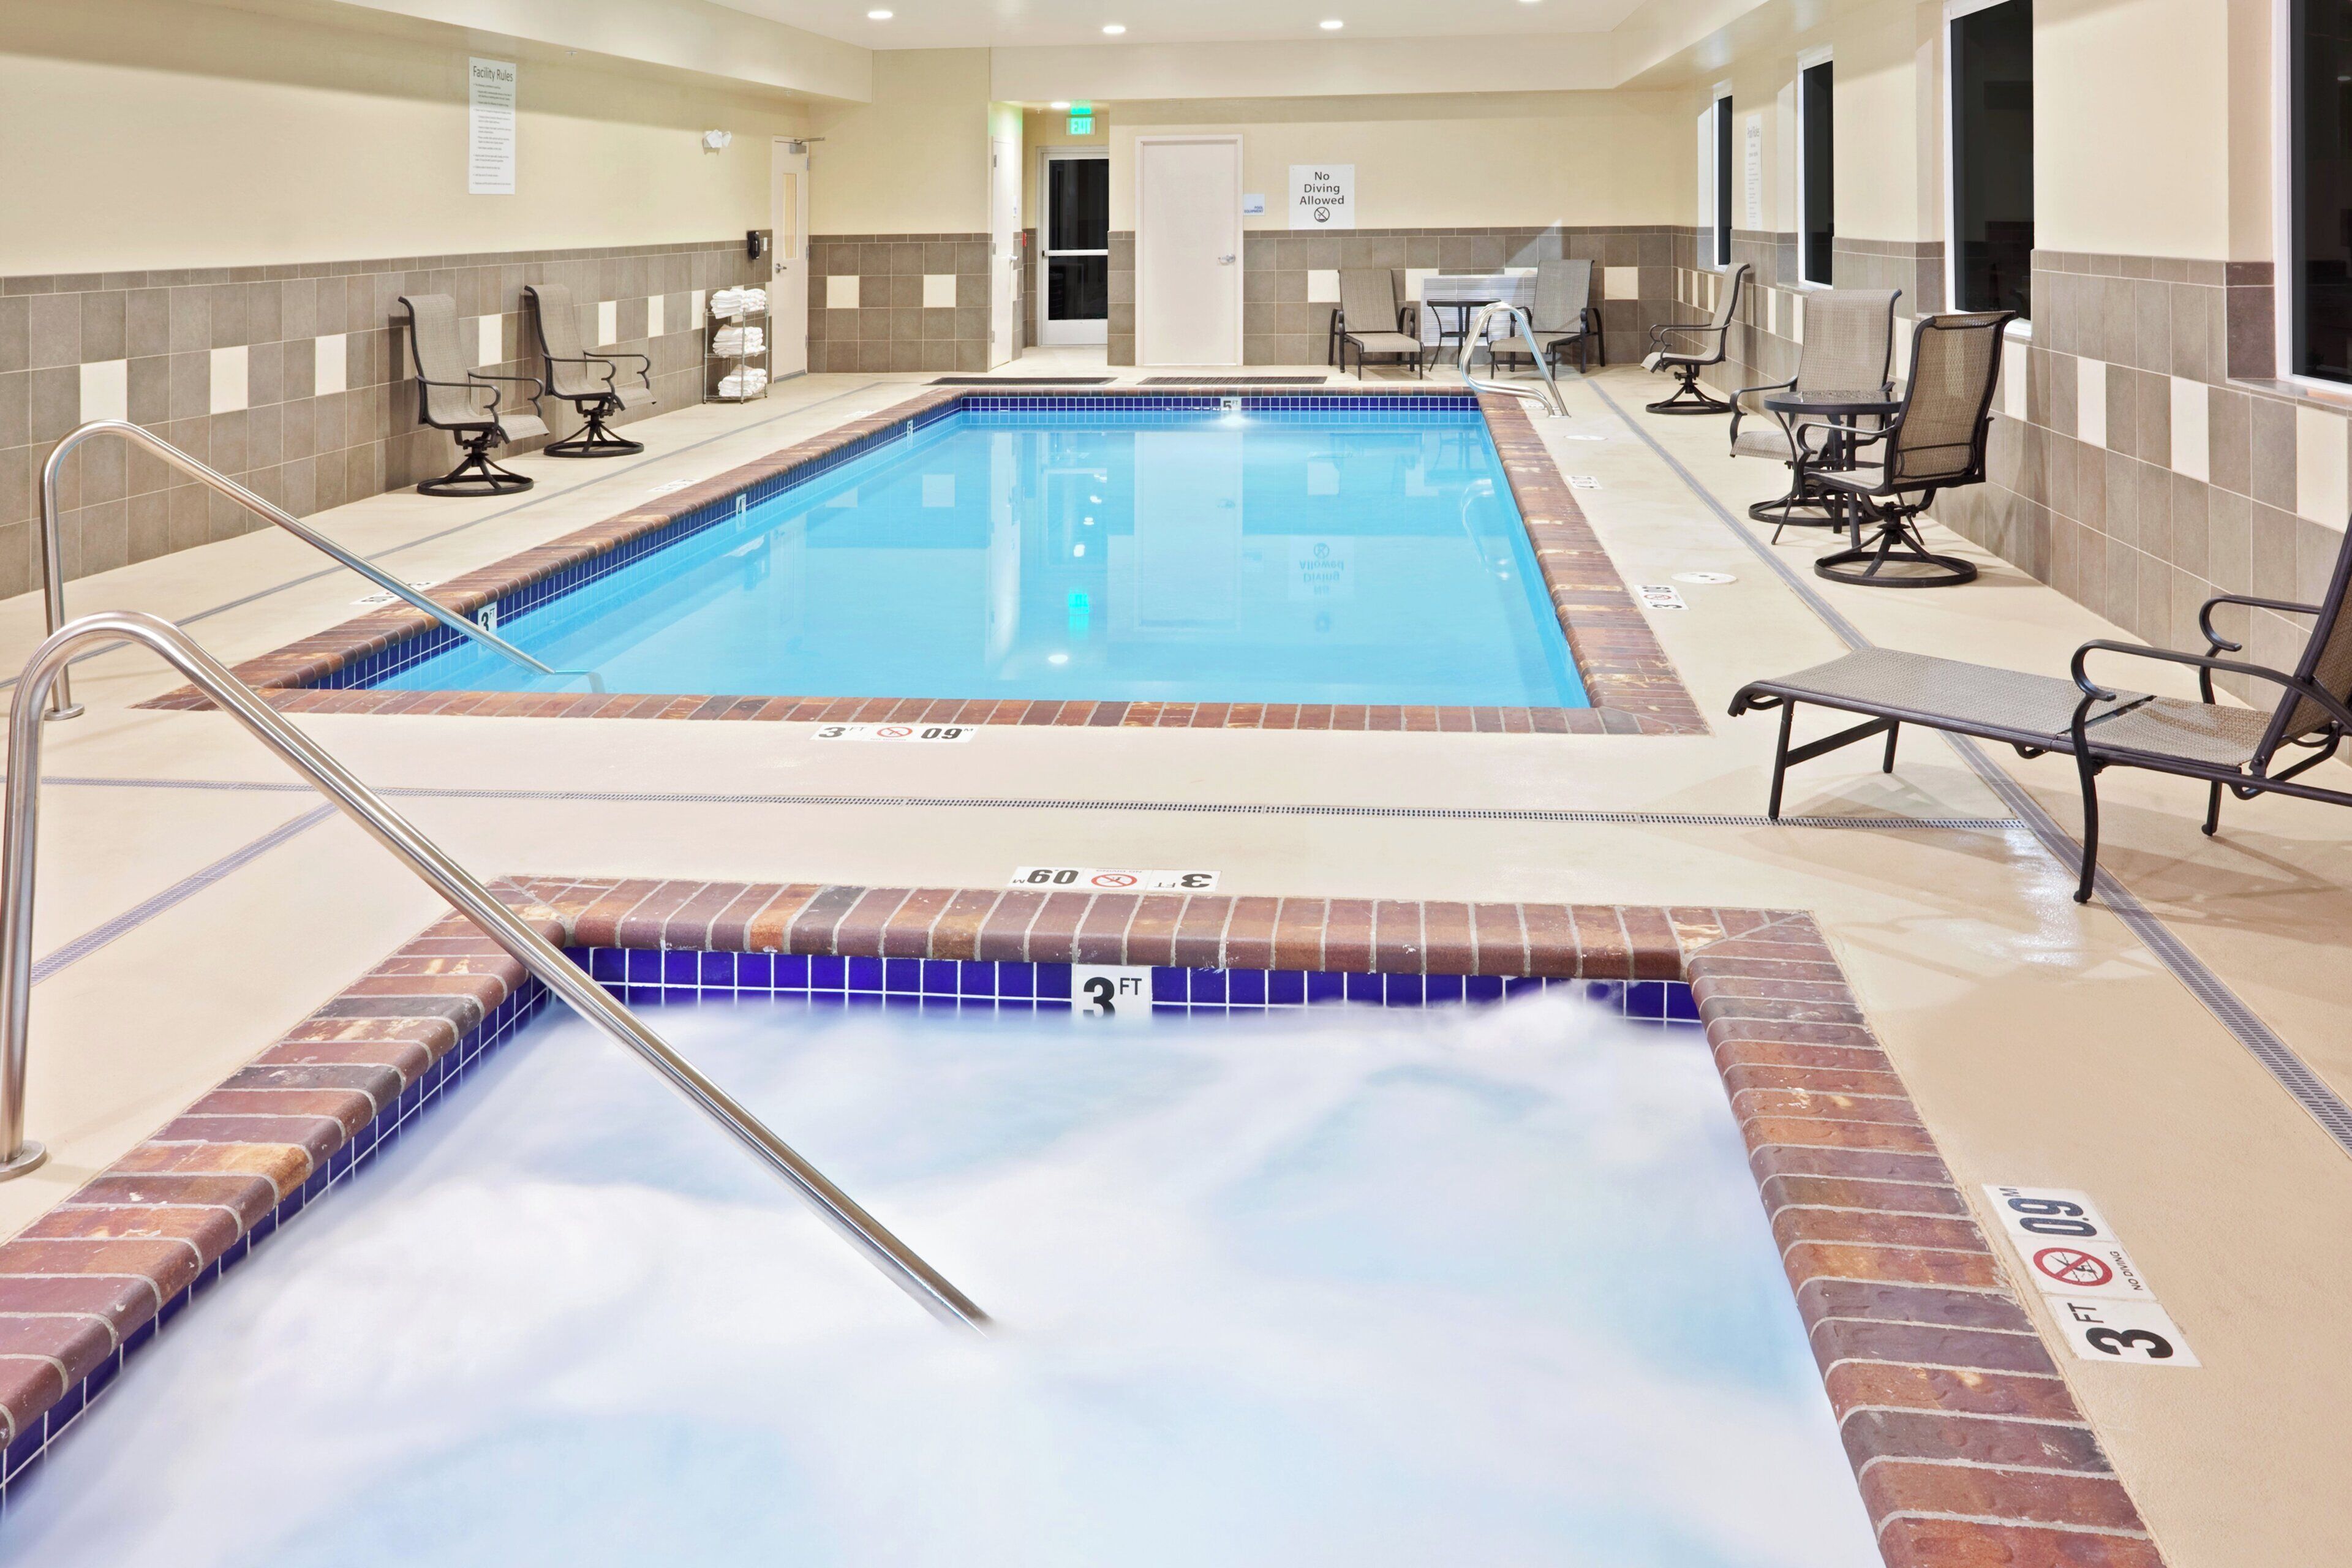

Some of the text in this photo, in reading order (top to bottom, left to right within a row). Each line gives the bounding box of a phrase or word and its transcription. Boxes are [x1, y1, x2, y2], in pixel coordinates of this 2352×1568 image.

[473, 66, 513, 82] Facility Rules
[1070, 117, 1091, 134] EXIT
[1314, 172, 1330, 181] No
[1304, 184, 1340, 195] Diving
[1300, 195, 1344, 205] Allowed
[1223, 400, 1232, 410] 5
[738, 499, 742, 514] 4
[481, 608, 495, 631] 3 FT
[818, 727, 846, 737] 3
[1180, 873, 1213, 888] 3
[1083, 976, 1142, 1019] 3 FT
[1999, 1188, 2021, 1197] M
[2109, 1250, 2143, 1291] NO DIVING
[2067, 1302, 2174, 1359] 3 FT
